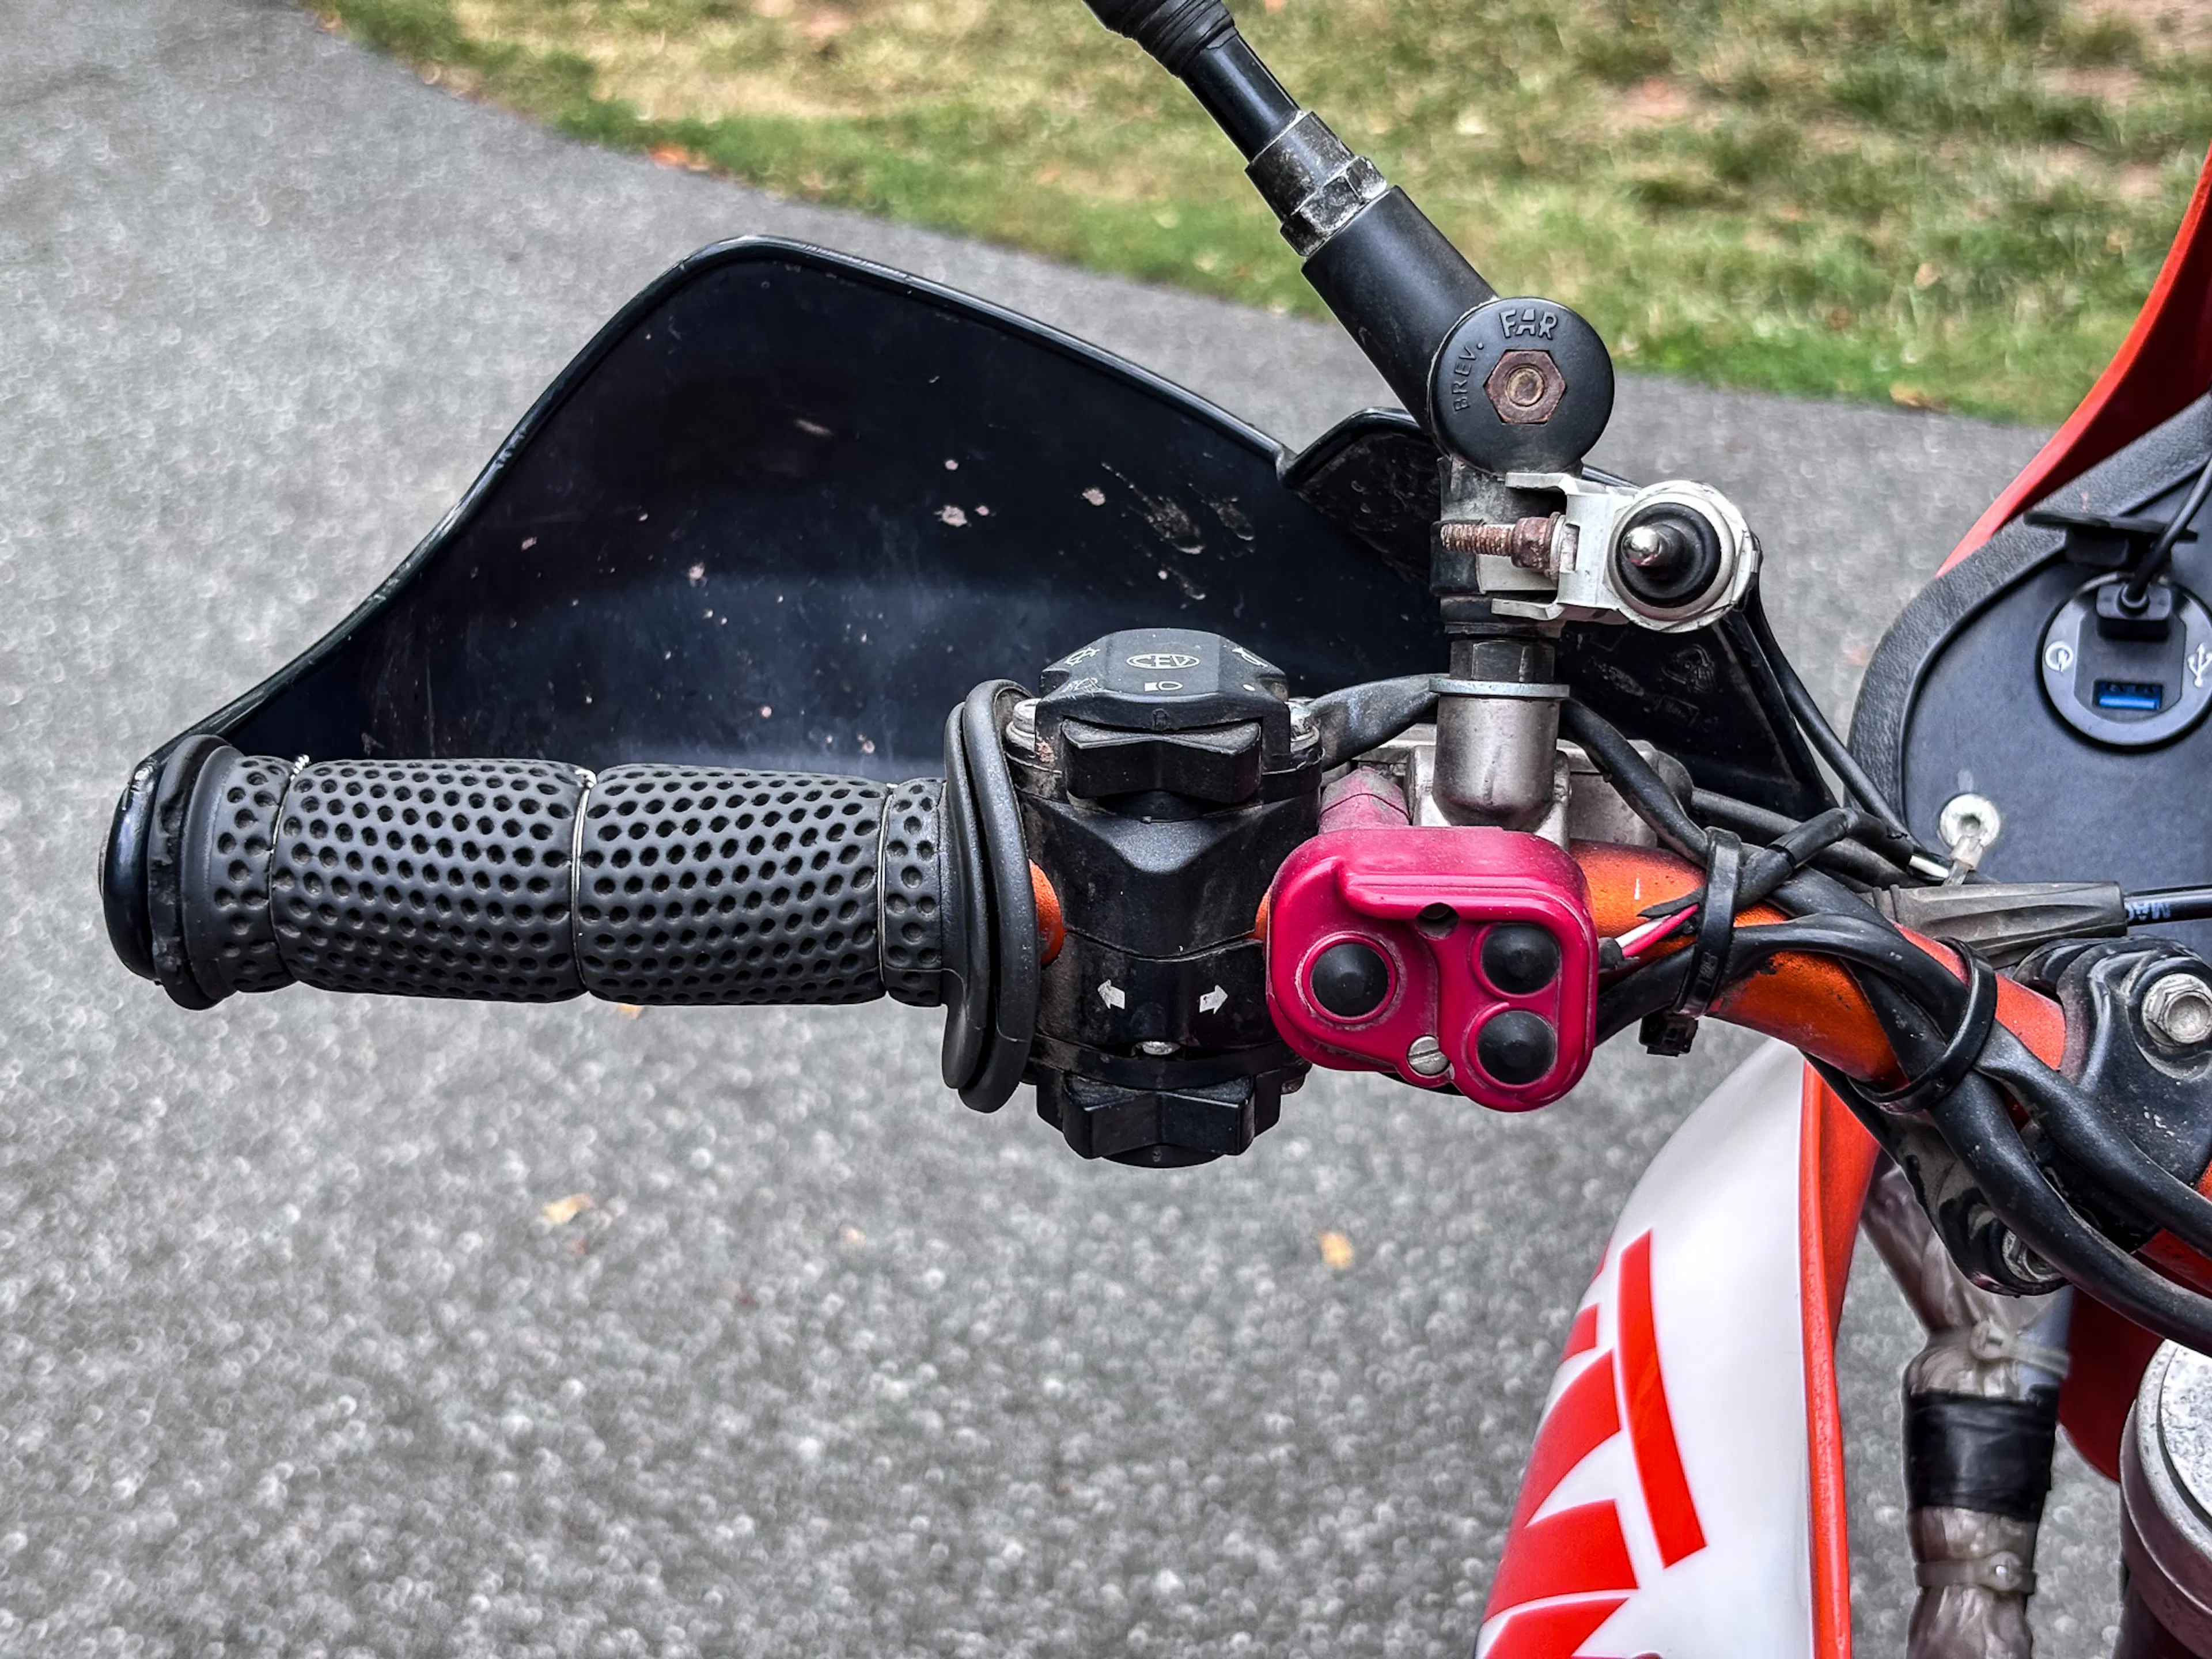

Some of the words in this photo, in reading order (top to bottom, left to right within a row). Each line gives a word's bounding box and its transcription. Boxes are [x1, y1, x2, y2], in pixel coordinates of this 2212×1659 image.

[1452, 342, 1484, 412] BREV.
[1499, 308, 1558, 340] FAR
[1131, 654, 1192, 668] CEV
